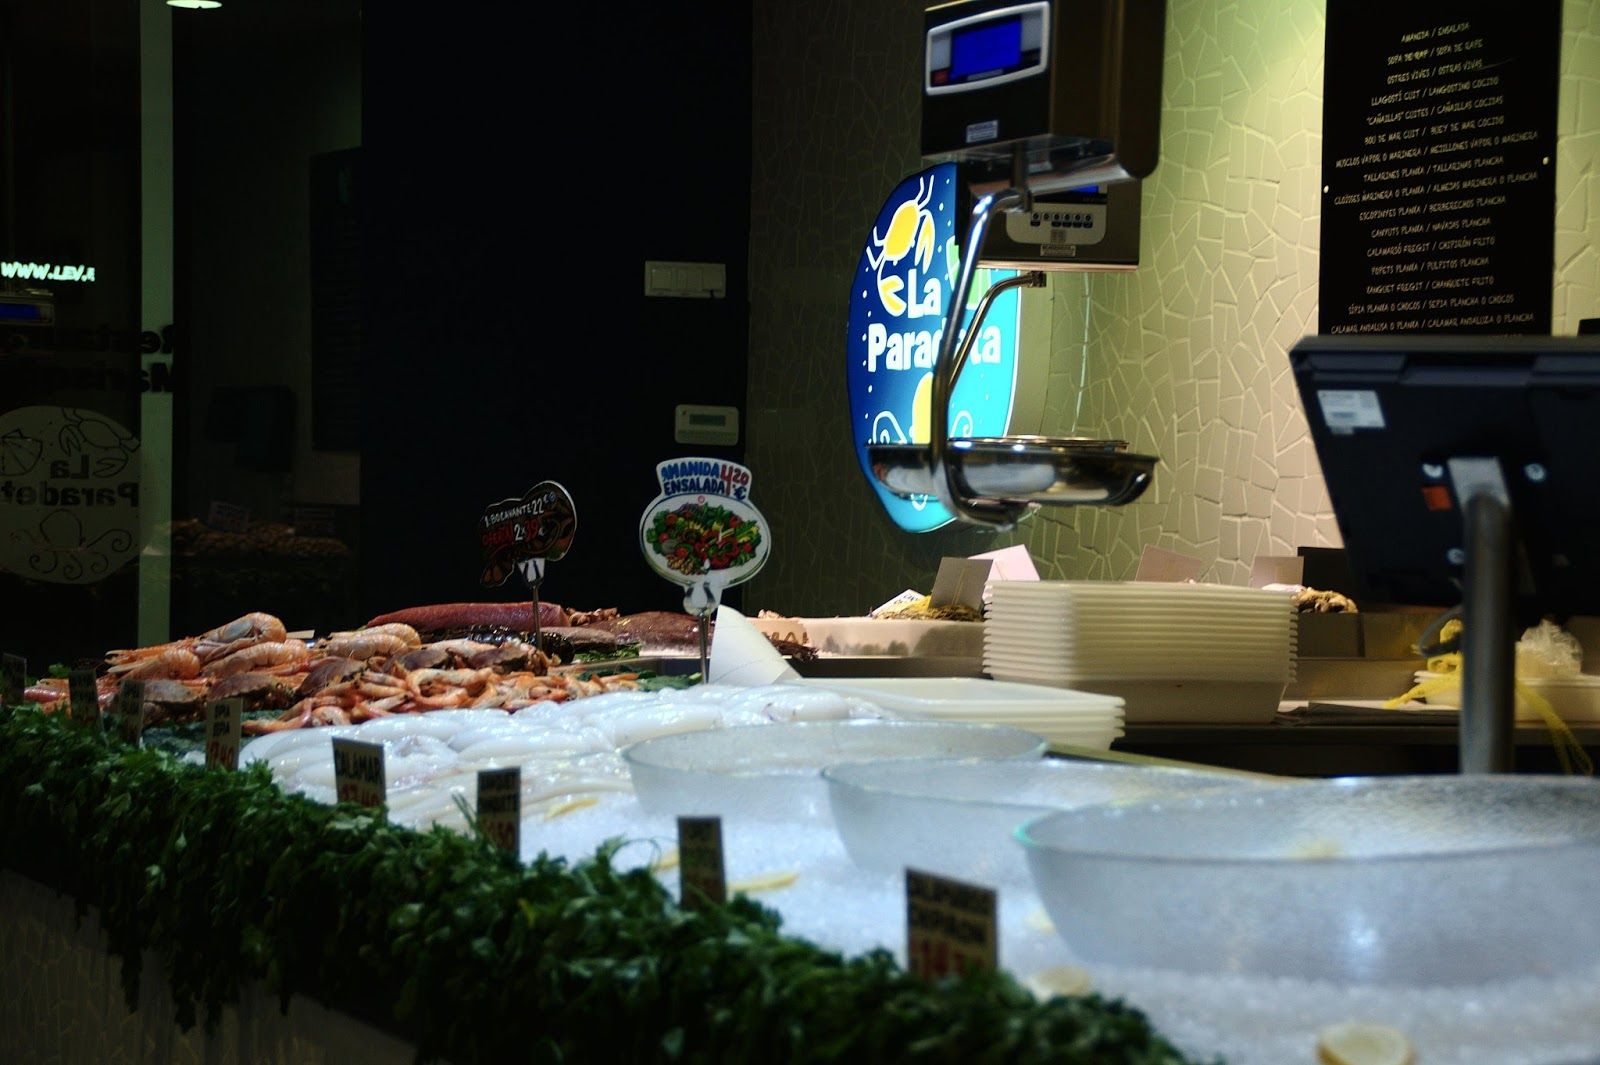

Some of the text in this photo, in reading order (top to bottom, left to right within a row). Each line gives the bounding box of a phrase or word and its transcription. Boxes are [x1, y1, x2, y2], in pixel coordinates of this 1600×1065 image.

[908, 268, 942, 319] La
[867, 317, 1002, 373] Paradta
[661, 461, 720, 481] AMANIDA
[664, 477, 725, 495] ENSALADA
